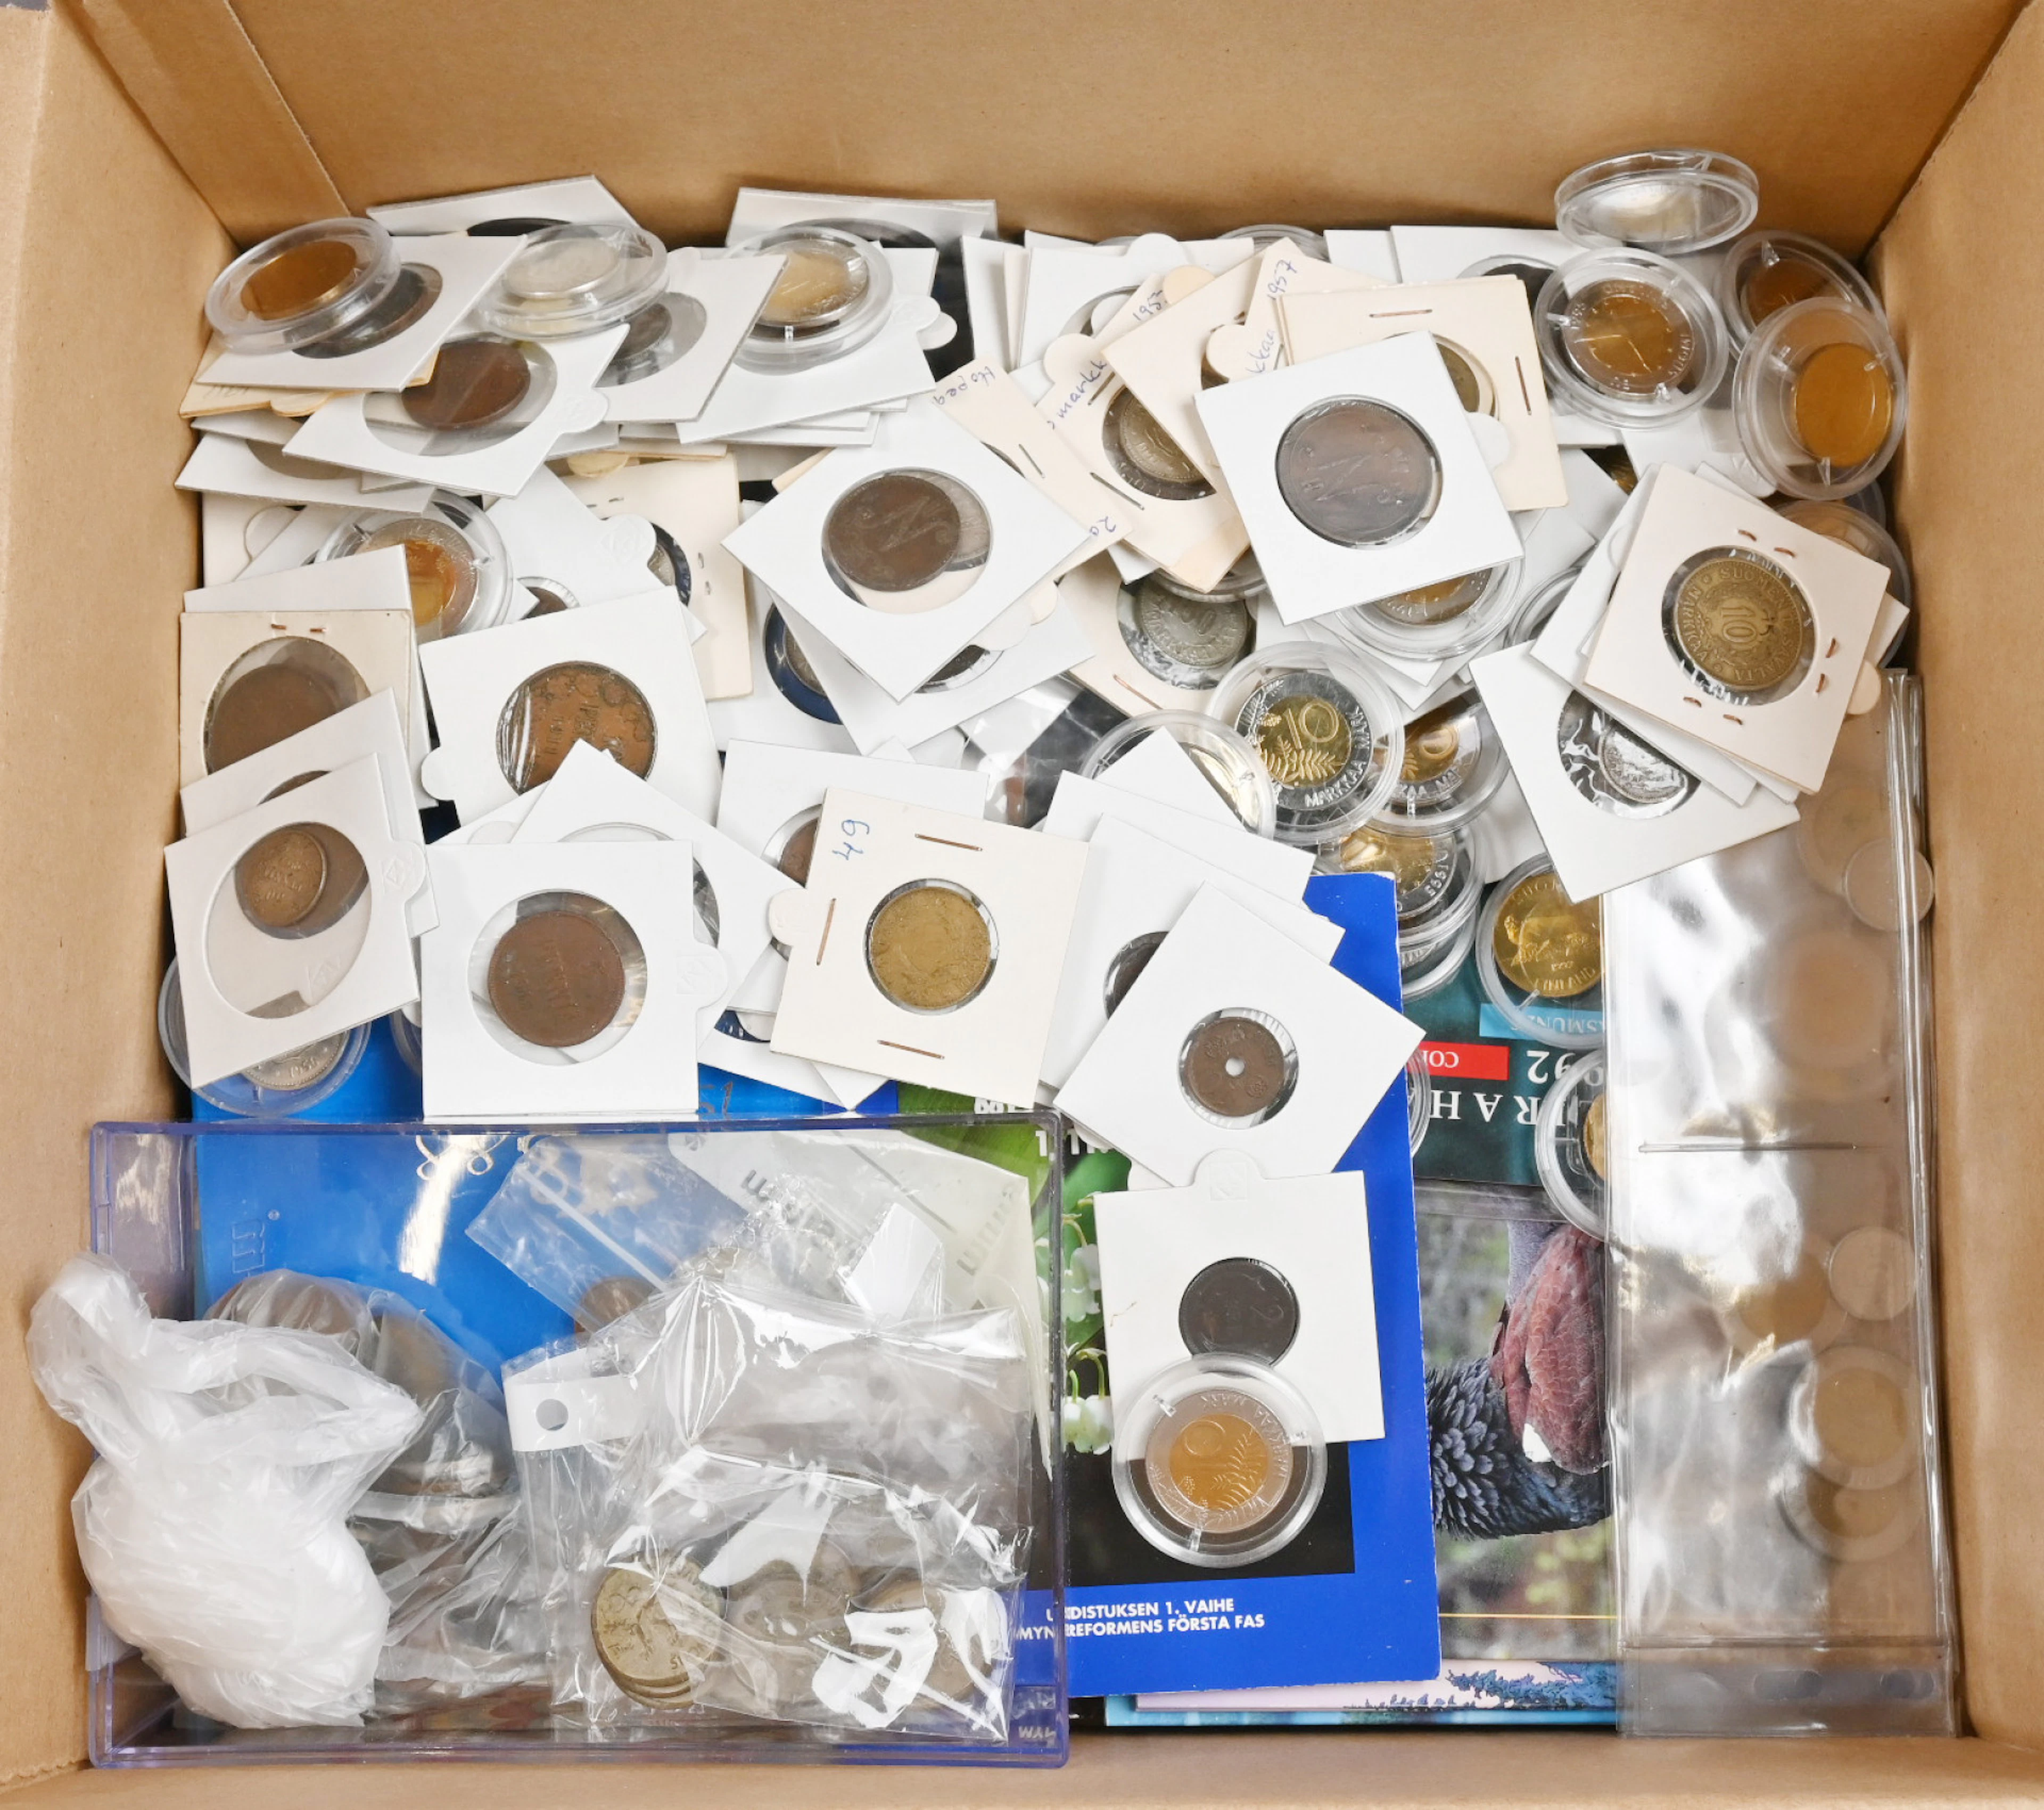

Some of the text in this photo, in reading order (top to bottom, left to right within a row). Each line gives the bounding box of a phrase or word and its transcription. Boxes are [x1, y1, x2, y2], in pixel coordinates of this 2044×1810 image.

[1057, 358, 1110, 421] markk
[1720, 606, 1758, 644] 10
[1282, 698, 1339, 750] 10
[1165, 1602, 1180, 1616] 1.
[1183, 1598, 1235, 1614] VAIHE
[1168, 1614, 1230, 1632] FÖRSTA
[1235, 1614, 1265, 1628] FAS
